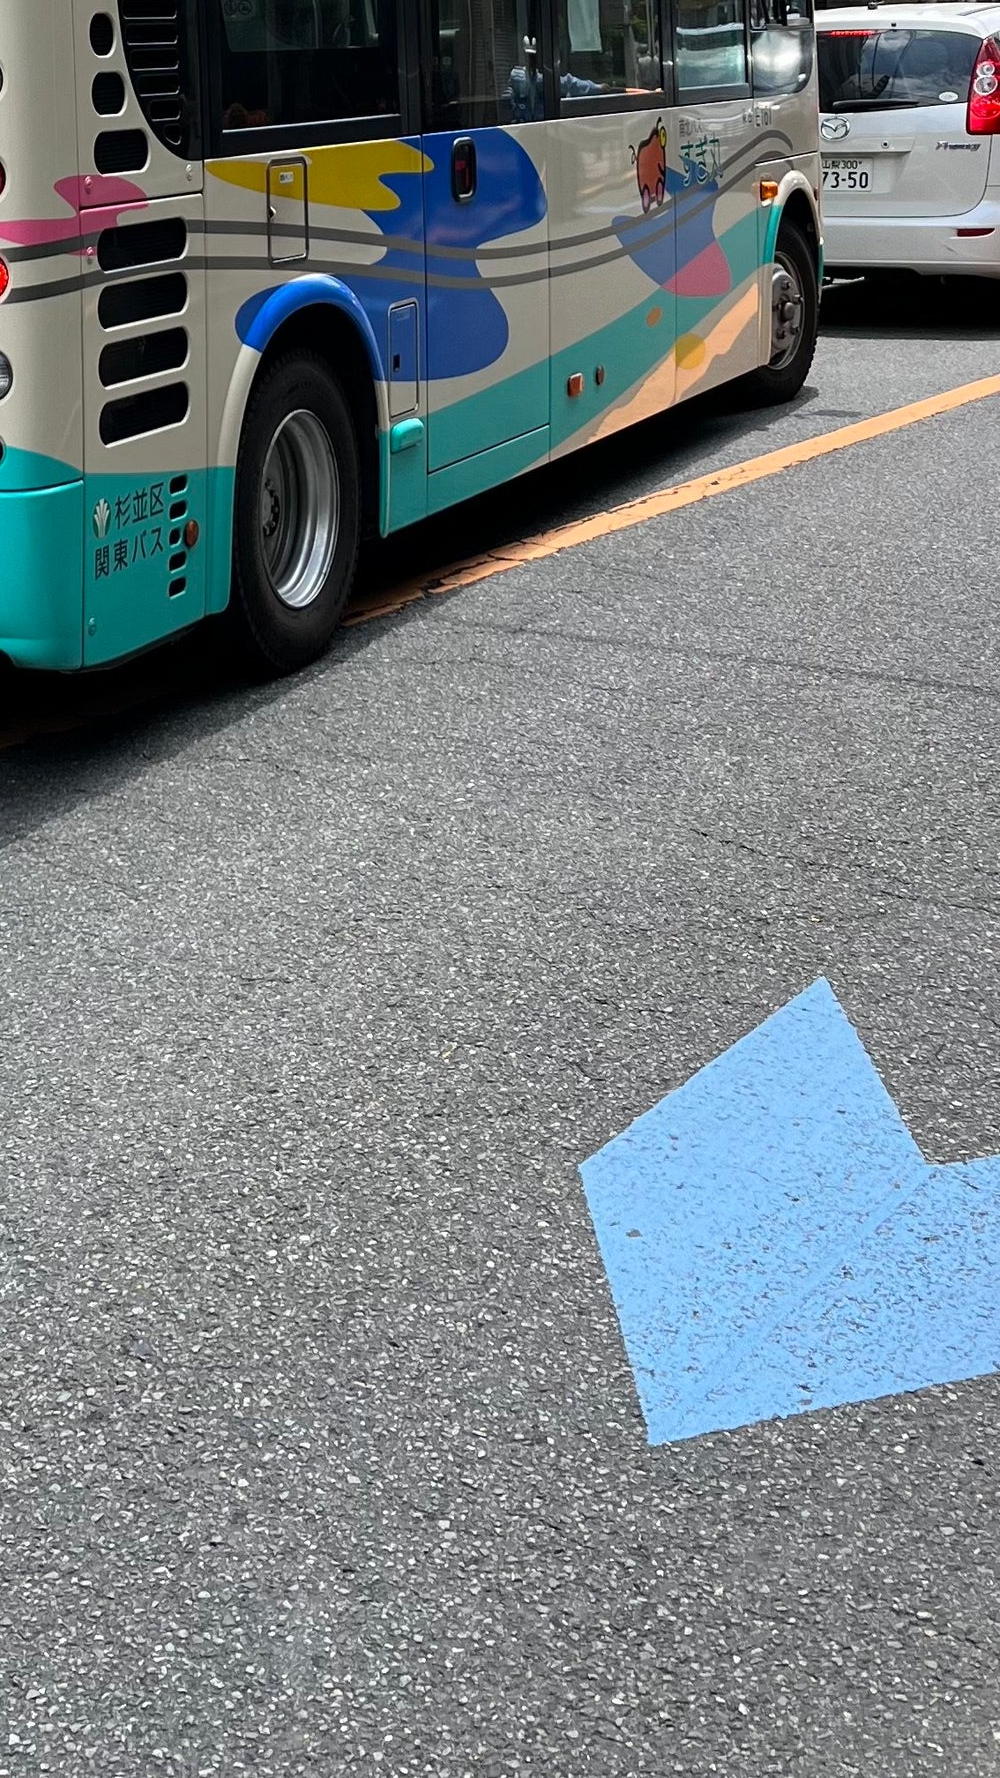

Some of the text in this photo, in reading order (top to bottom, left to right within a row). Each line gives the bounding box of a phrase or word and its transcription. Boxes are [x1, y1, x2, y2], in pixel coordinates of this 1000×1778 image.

[822, 171, 869, 189] 73-50
[114, 481, 164, 530] 杉並区
[94, 526, 164, 580] 関東バス
